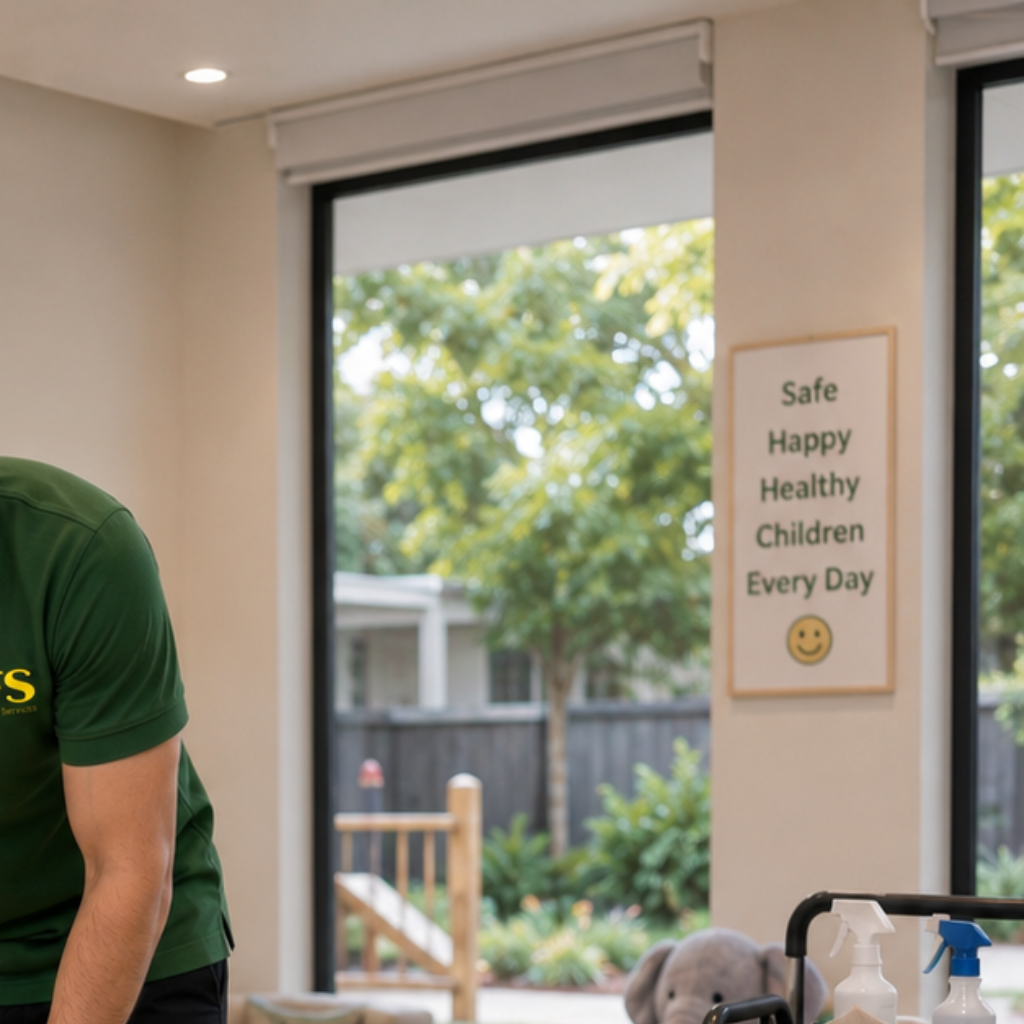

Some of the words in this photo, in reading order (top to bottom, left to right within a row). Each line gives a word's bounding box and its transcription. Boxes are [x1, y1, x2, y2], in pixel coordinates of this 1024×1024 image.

[781, 376, 839, 406] Safe
[768, 428, 852, 457] Happy
[760, 471, 861, 502] Healthy
[756, 520, 865, 549] Children
[747, 570, 817, 600] Every
[825, 566, 874, 596] Day
